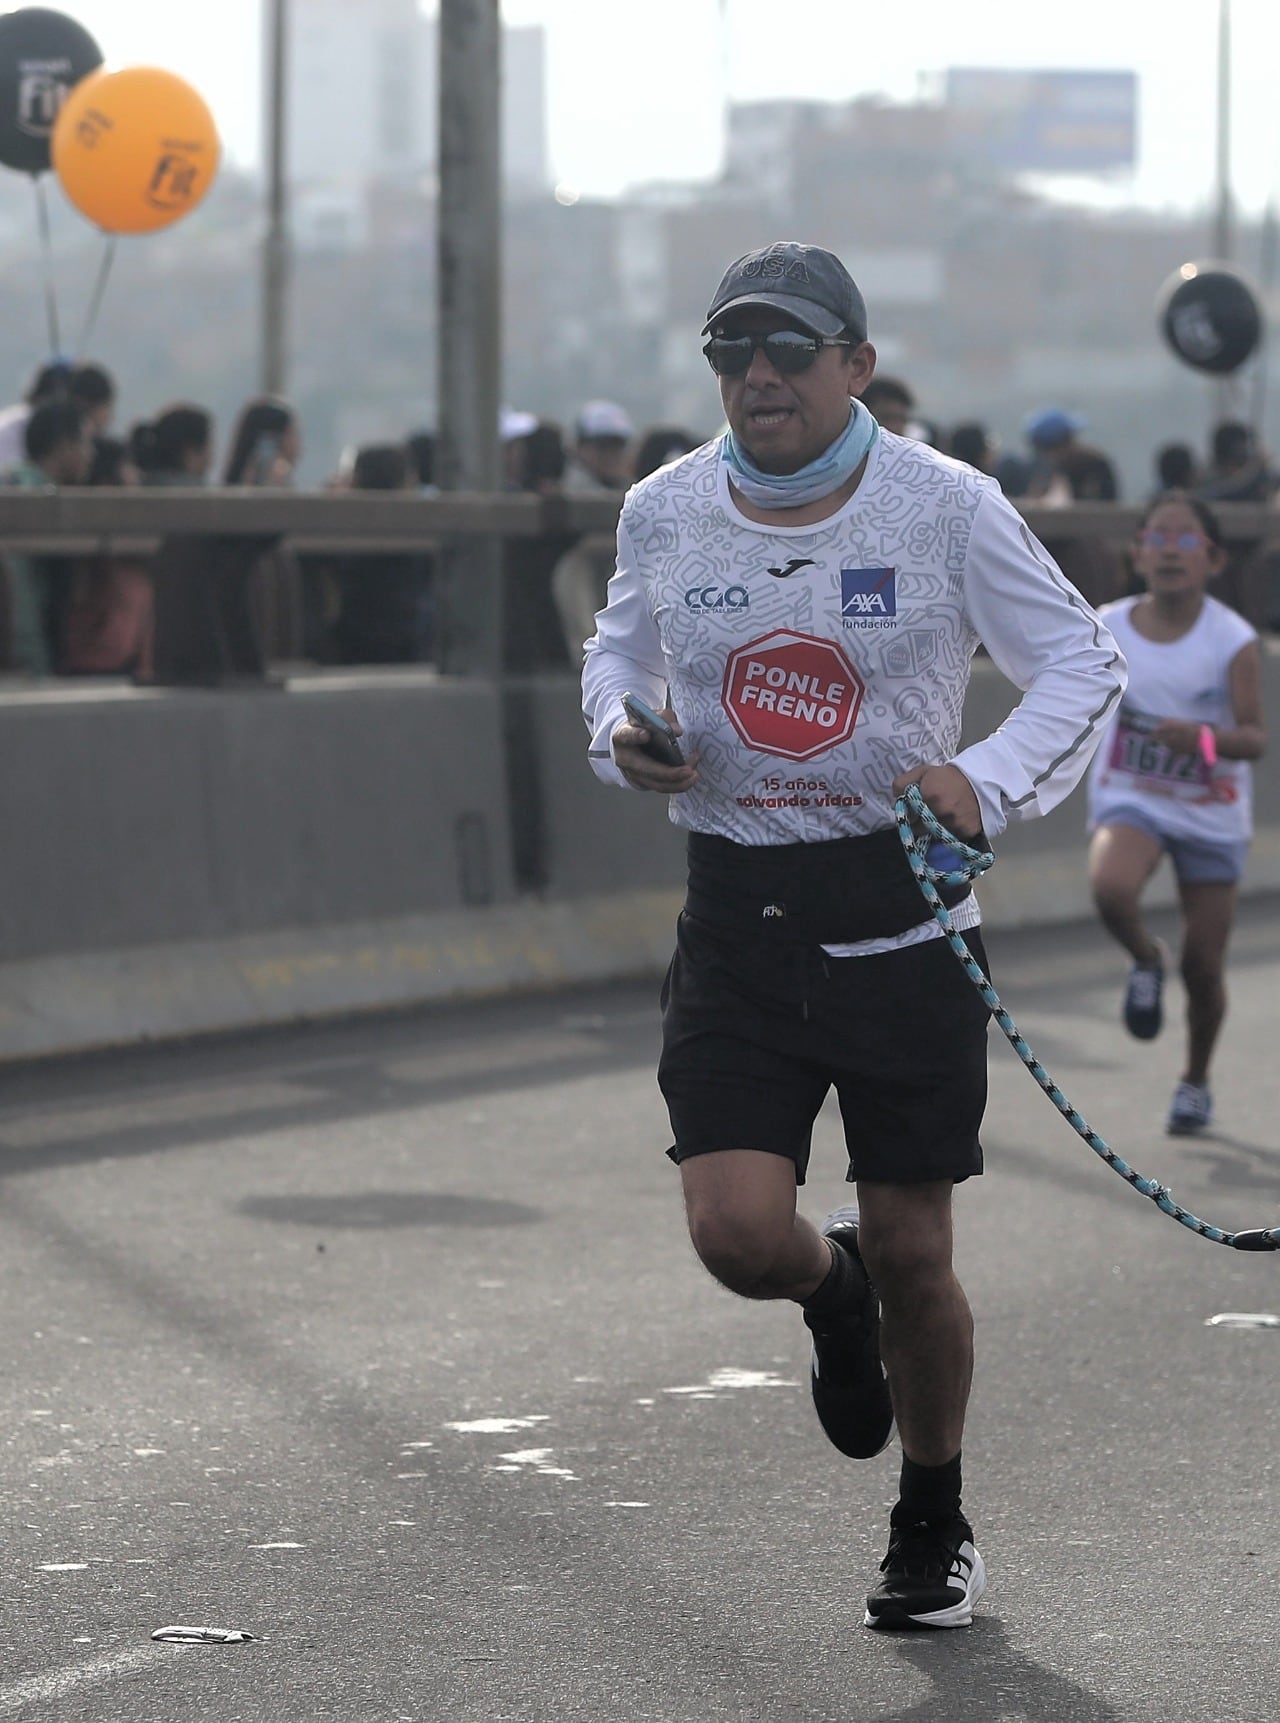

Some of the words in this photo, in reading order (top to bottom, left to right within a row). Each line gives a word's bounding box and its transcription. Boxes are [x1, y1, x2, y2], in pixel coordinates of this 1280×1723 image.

[741, 256, 810, 283] USA
[842, 593, 888, 613] AXA
[842, 618, 897, 629] fundación
[745, 661, 845, 704] PONLE
[740, 685, 838, 727] FRENO
[761, 778, 780, 790] 15
[785, 778, 827, 791] años
[815, 794, 863, 807] vidas
